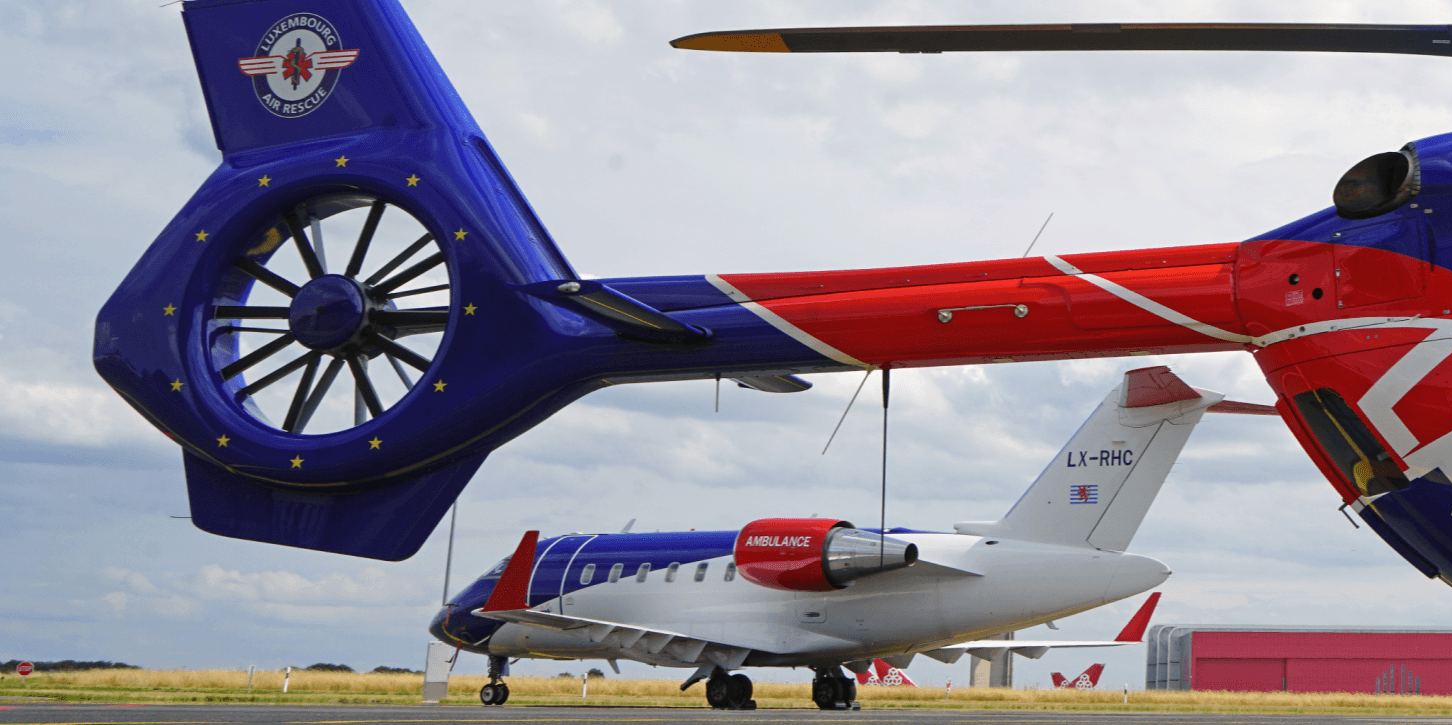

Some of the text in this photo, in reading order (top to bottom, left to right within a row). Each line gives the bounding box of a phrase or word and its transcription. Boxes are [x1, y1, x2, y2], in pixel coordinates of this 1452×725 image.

[261, 16, 337, 51] LUXEMBOURG
[262, 86, 327, 114] AIR RESCUE
[1067, 449, 1134, 468] LX-RHC
[745, 535, 812, 547] AMBULANCE
